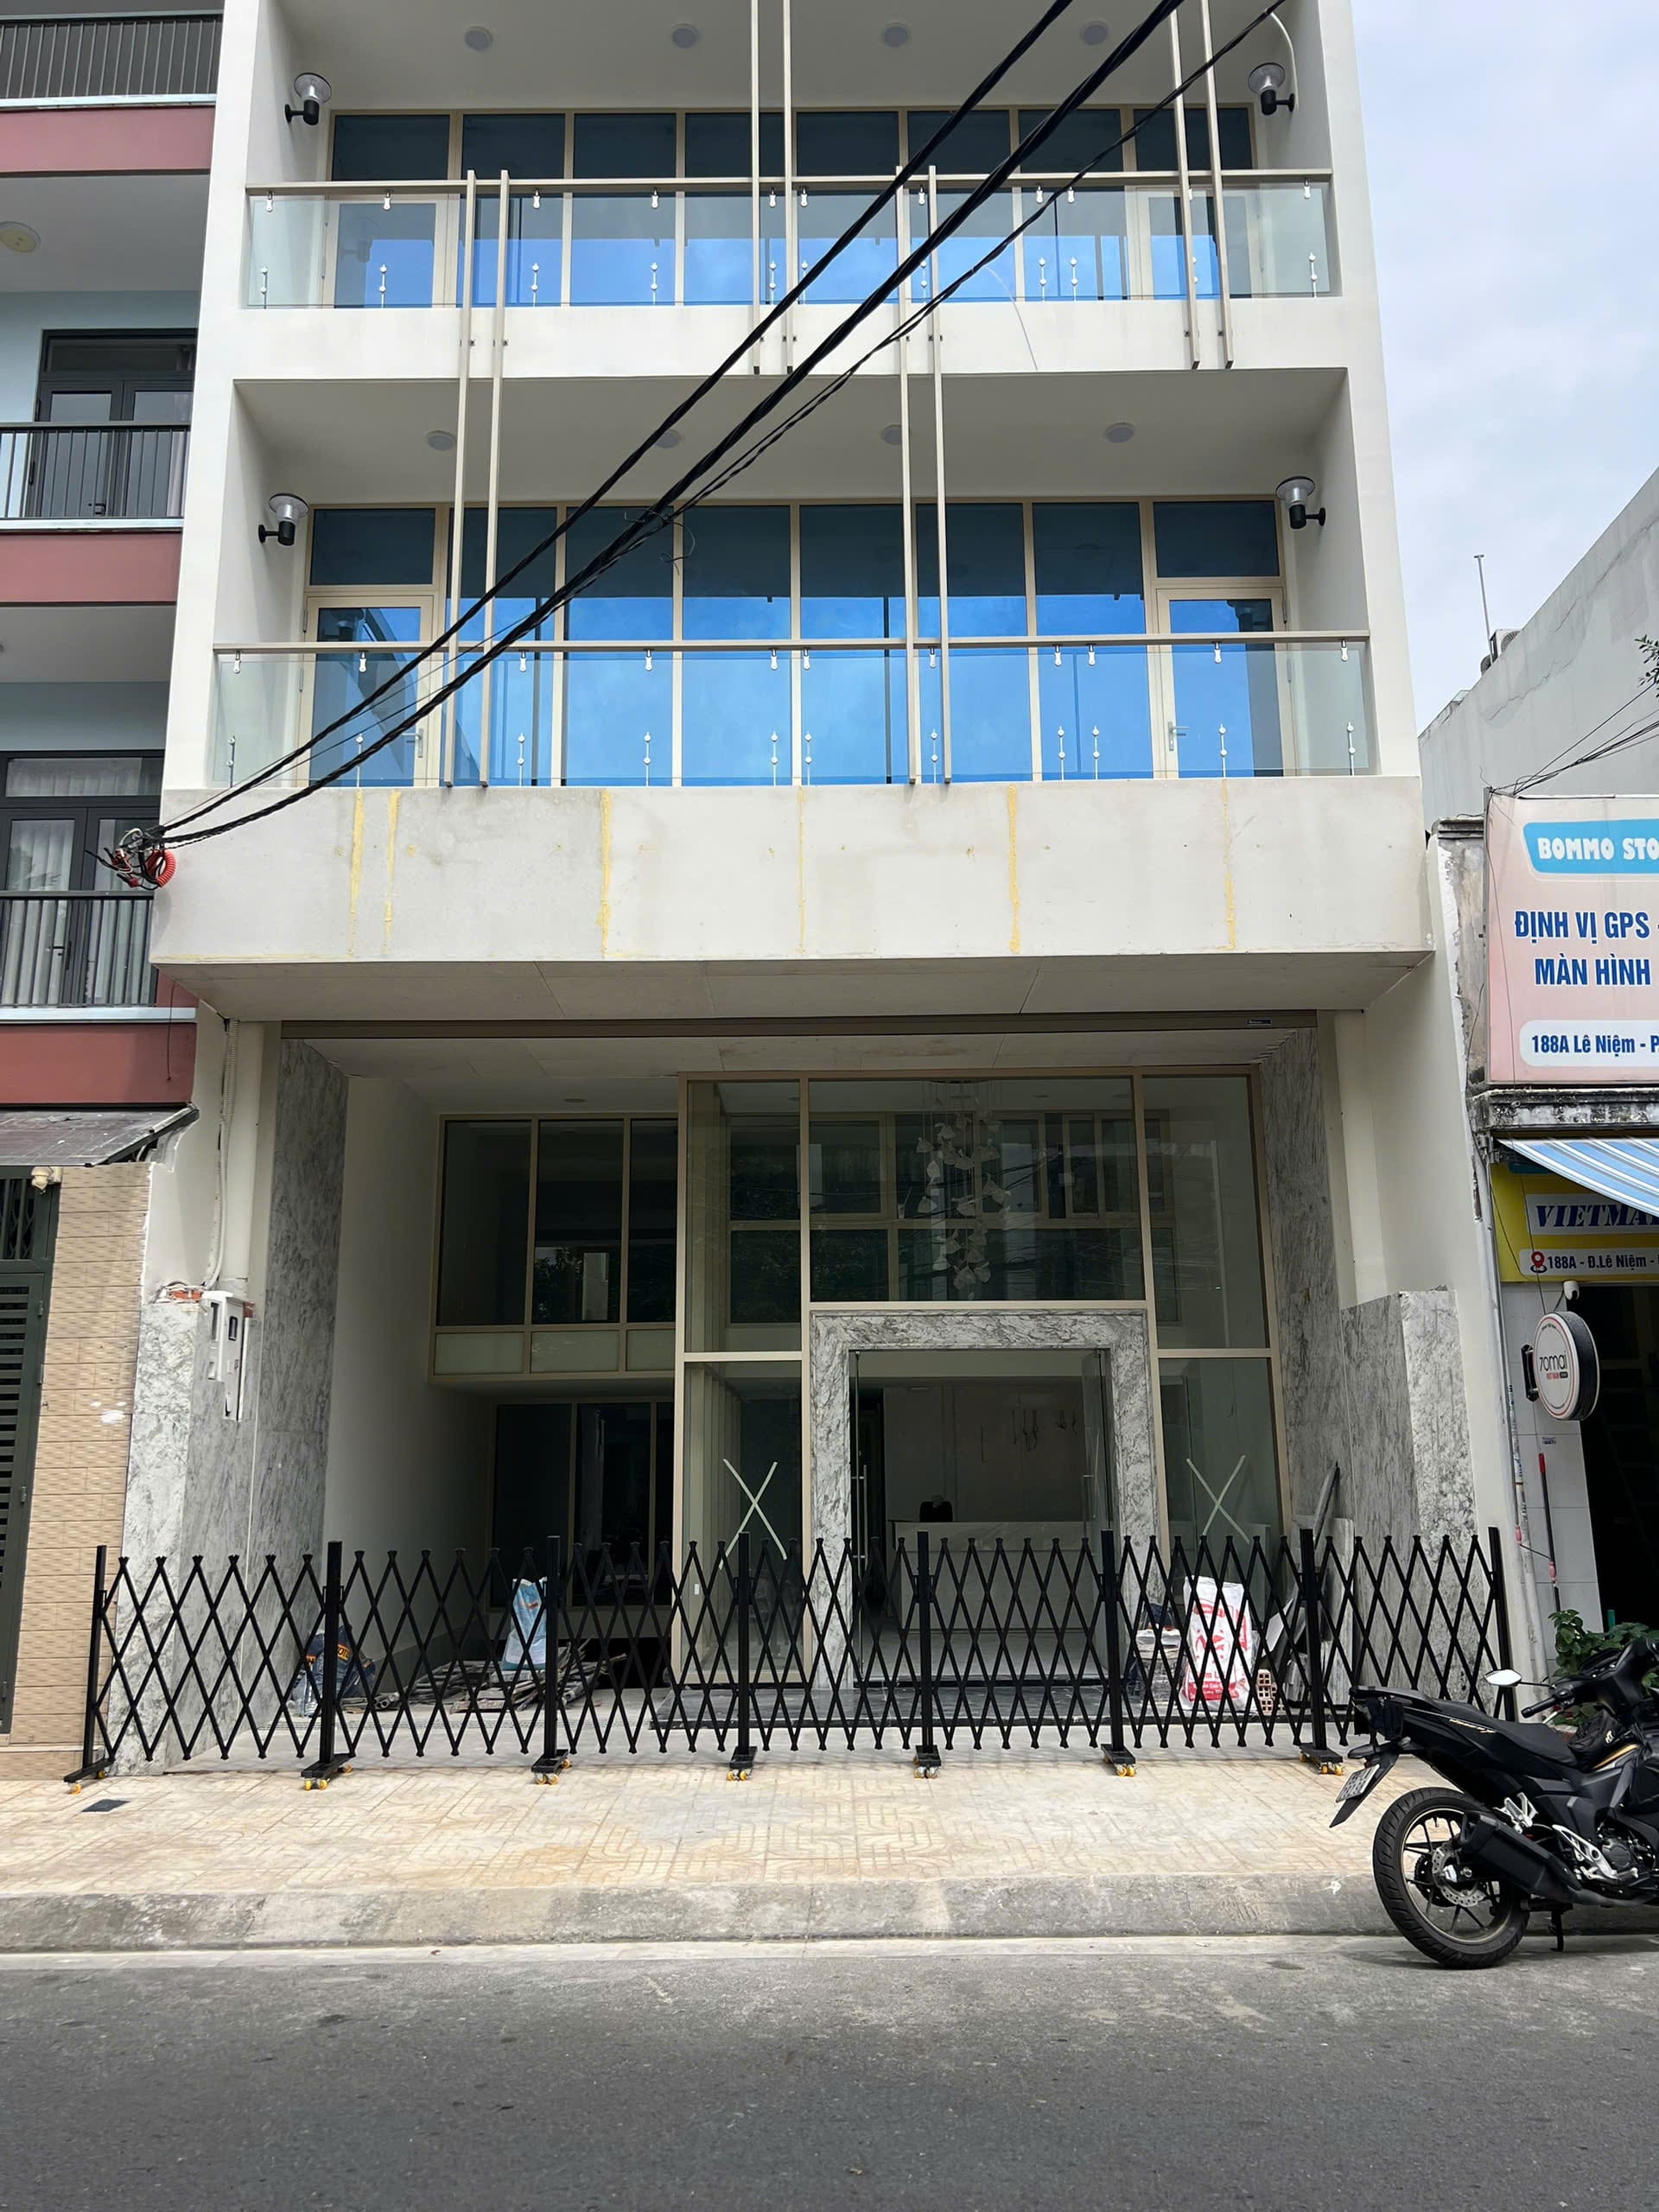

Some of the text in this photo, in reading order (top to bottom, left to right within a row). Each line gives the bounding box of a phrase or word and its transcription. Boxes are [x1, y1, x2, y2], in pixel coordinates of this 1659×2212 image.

[1537, 837, 1614, 861] BOMMO
[1515, 911, 1651, 944] ĐỊNH VỊ GPS
[1535, 952, 1651, 985] MÀN HÌNH
[1532, 1035, 1569, 1053] 188A
[1573, 1034, 1592, 1053] Lê
[1595, 1034, 1636, 1057] Niệm
[1547, 1255, 1577, 1269] 188A
[1587, 1255, 1613, 1269] Đ.Lê
[1616, 1255, 1648, 1272] Niệm
